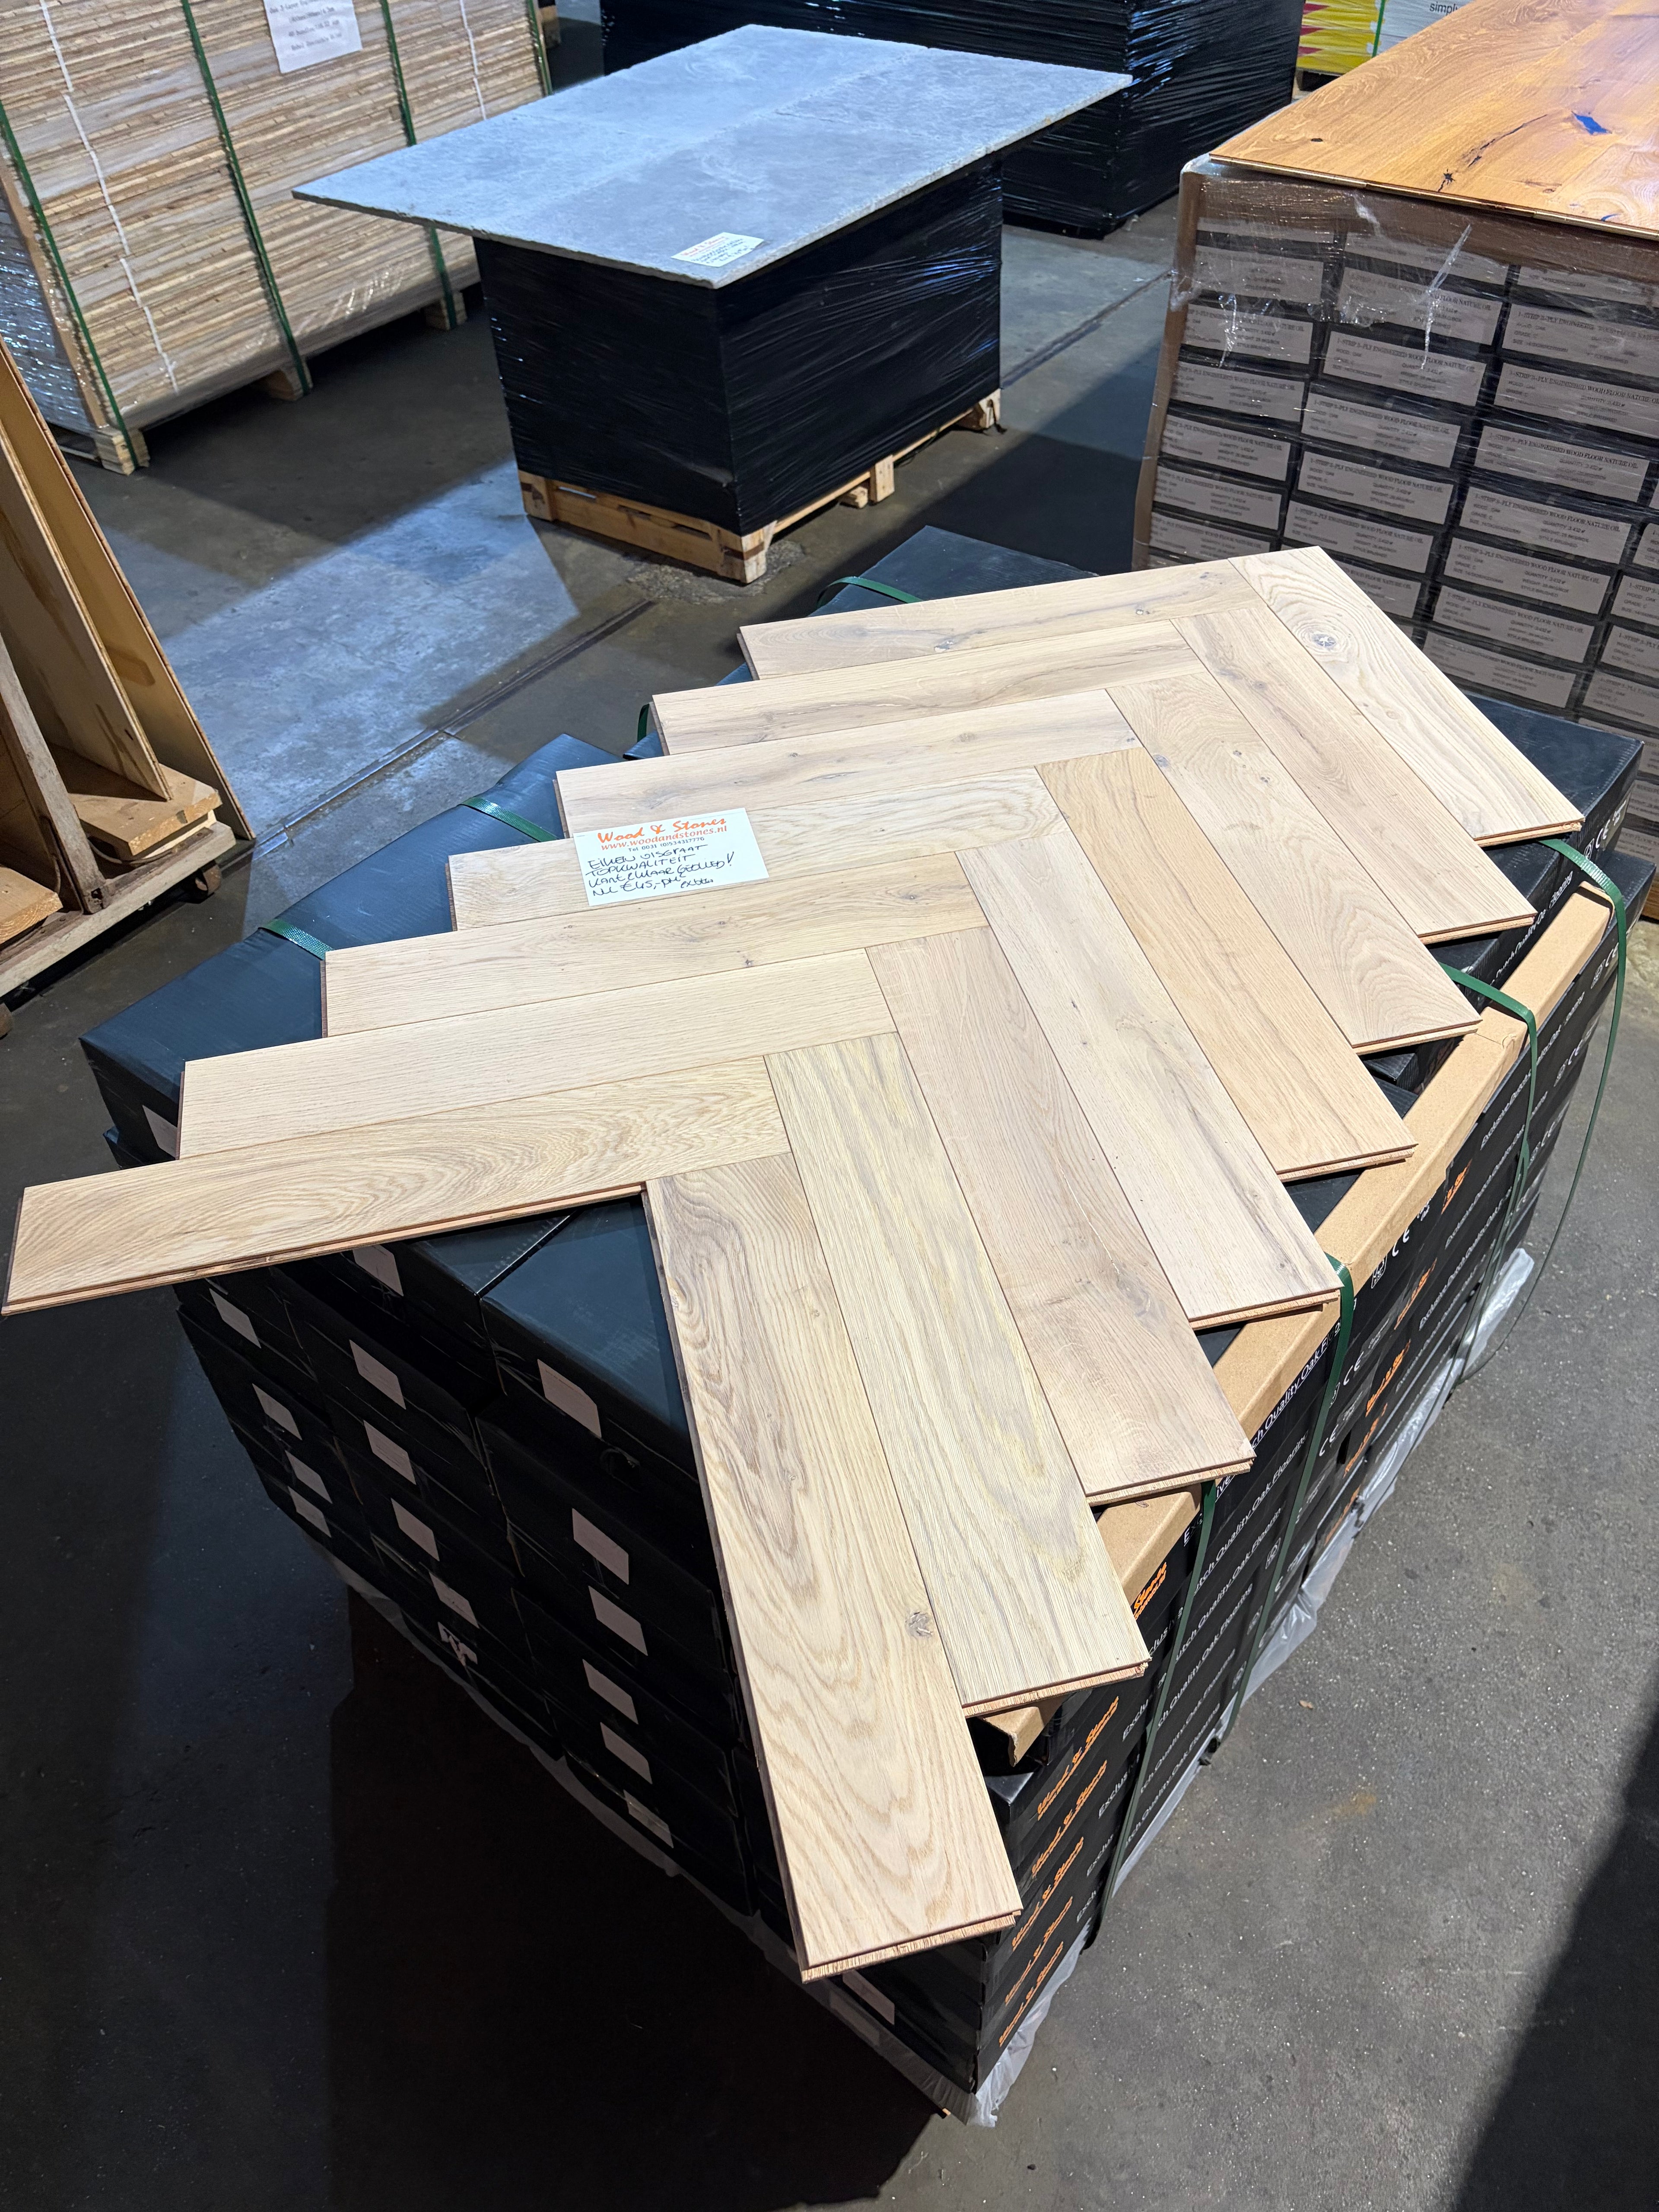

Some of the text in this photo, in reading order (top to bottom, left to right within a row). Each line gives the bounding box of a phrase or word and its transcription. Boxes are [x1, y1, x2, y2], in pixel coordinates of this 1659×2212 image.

[597, 818, 727, 843] Wood & Stones
[601, 825, 728, 851] www.woodandstones.nl
[1265, 1351, 1320, 1430] Quality Oak
[1215, 1511, 1251, 1565] Quality
[1252, 1483, 1271, 1514] Oak
[1198, 1580, 1232, 1631] Quality
[1231, 1552, 1250, 1583] Oak
[1170, 1662, 1200, 1711] Quality
[1201, 1634, 1219, 1664] Oak
